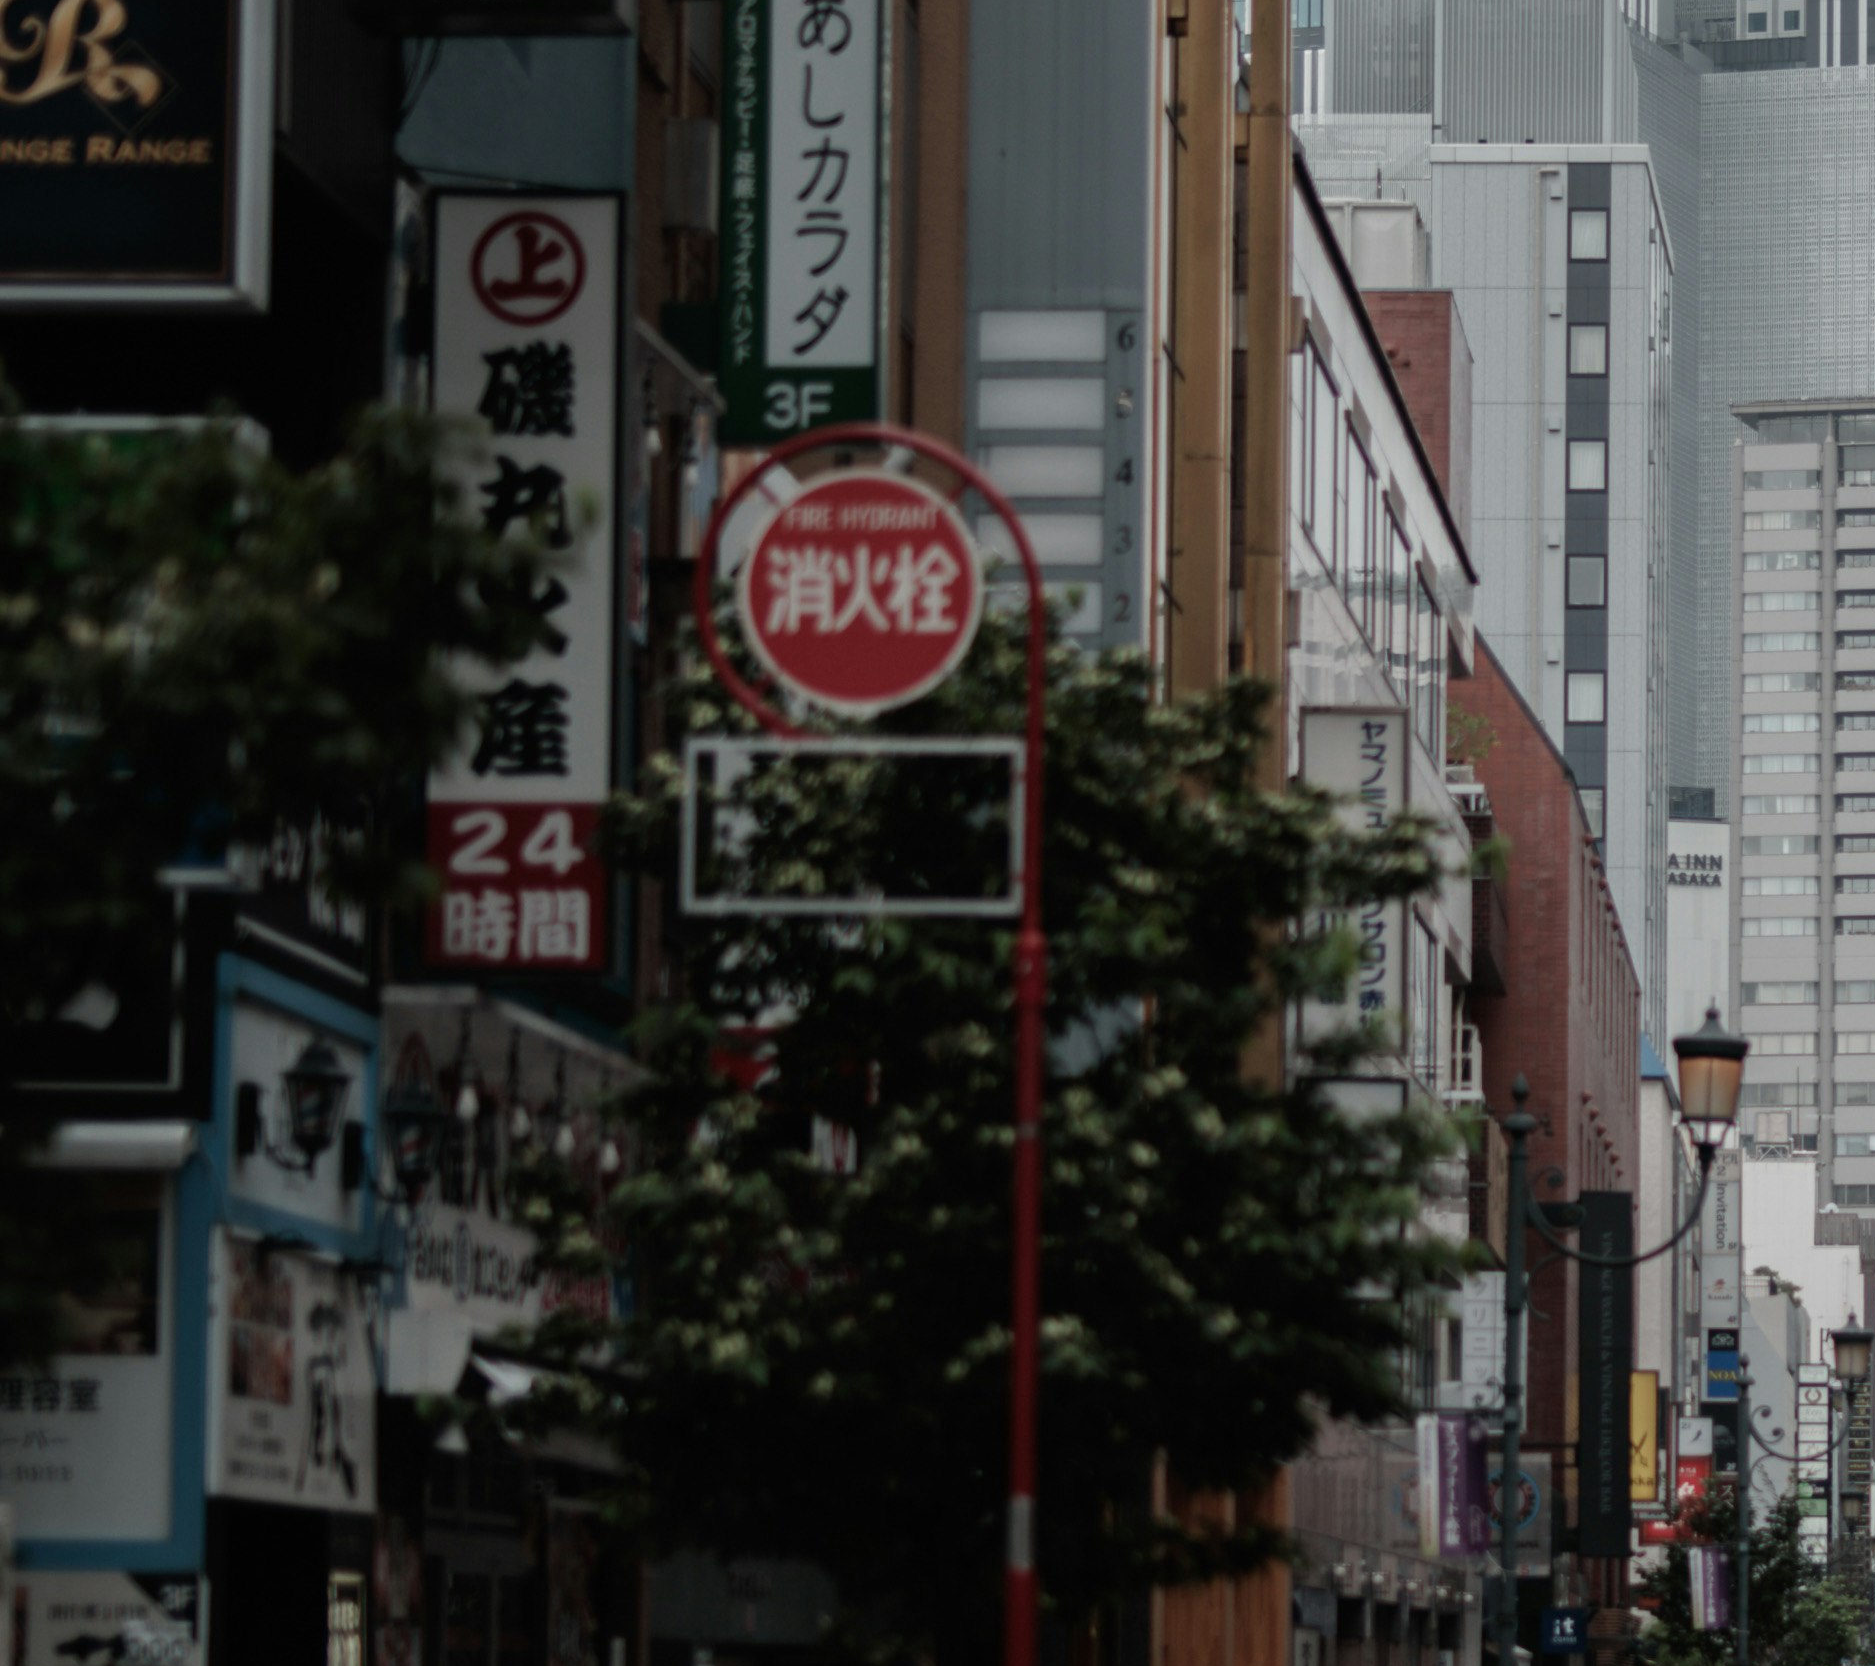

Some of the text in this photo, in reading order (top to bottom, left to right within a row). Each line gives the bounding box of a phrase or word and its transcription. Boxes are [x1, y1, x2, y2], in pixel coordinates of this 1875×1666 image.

[1117, 322, 1135, 352] 6
[763, 383, 834, 429] 3F
[1114, 458, 1134, 486] 4
[786, 507, 939, 532] FIRE HYDRANT
[1115, 526, 1134, 555] 3
[766, 542, 960, 634] 消火栓
[1114, 595, 1133, 624] 2
[450, 810, 586, 876] 24
[1686, 854, 1722, 870] INN
[1668, 872, 1722, 887] ASAKA
[442, 889, 591, 963] 時間
[1716, 1183, 1728, 1250] Invitation
[1709, 1369, 1738, 1381] NOA
[1554, 1616, 1574, 1635] it
